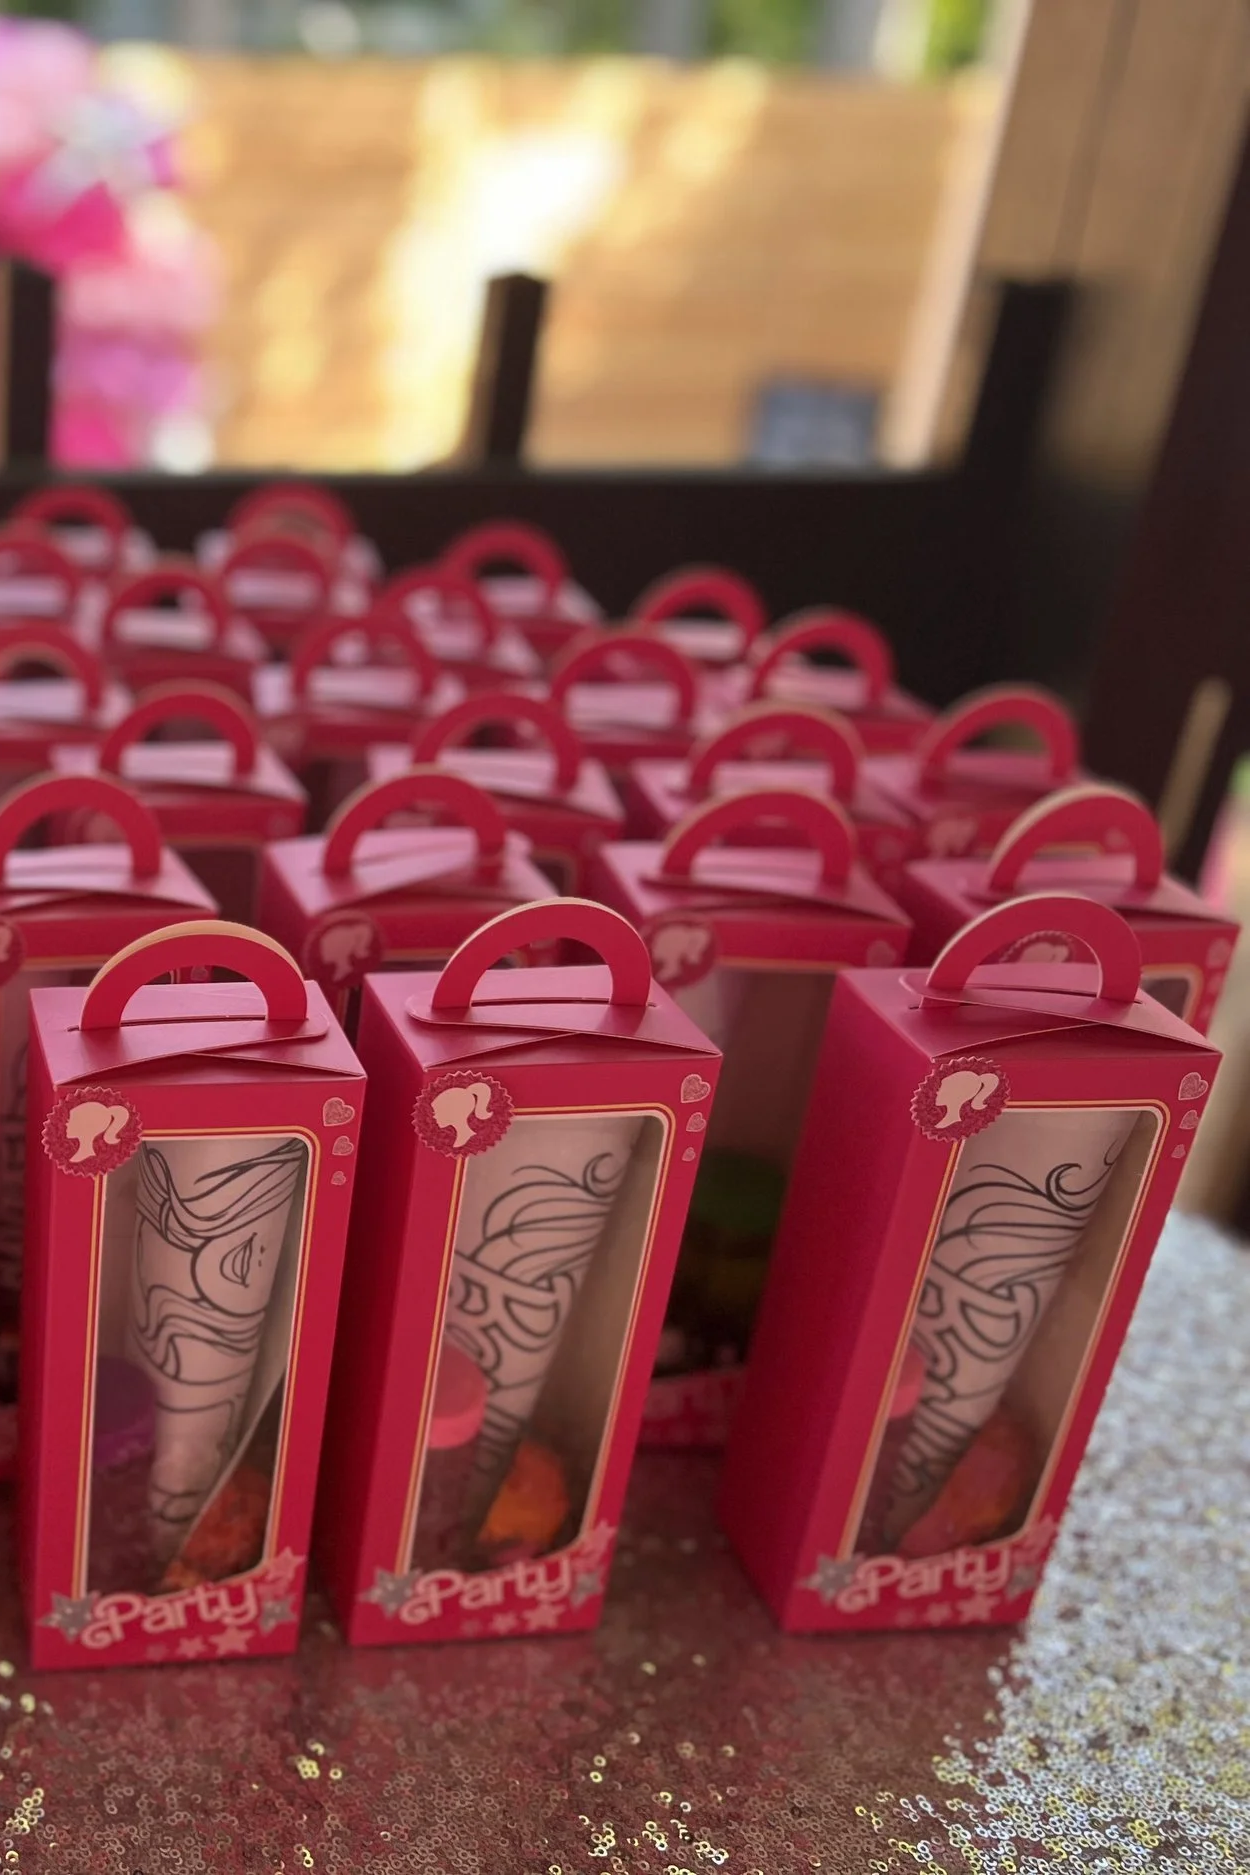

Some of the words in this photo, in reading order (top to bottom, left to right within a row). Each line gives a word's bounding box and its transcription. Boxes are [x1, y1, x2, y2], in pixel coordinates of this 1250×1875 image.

[399, 1555, 571, 1625] Party
[834, 1546, 1011, 1613] Party
[80, 1580, 260, 1649] Party
